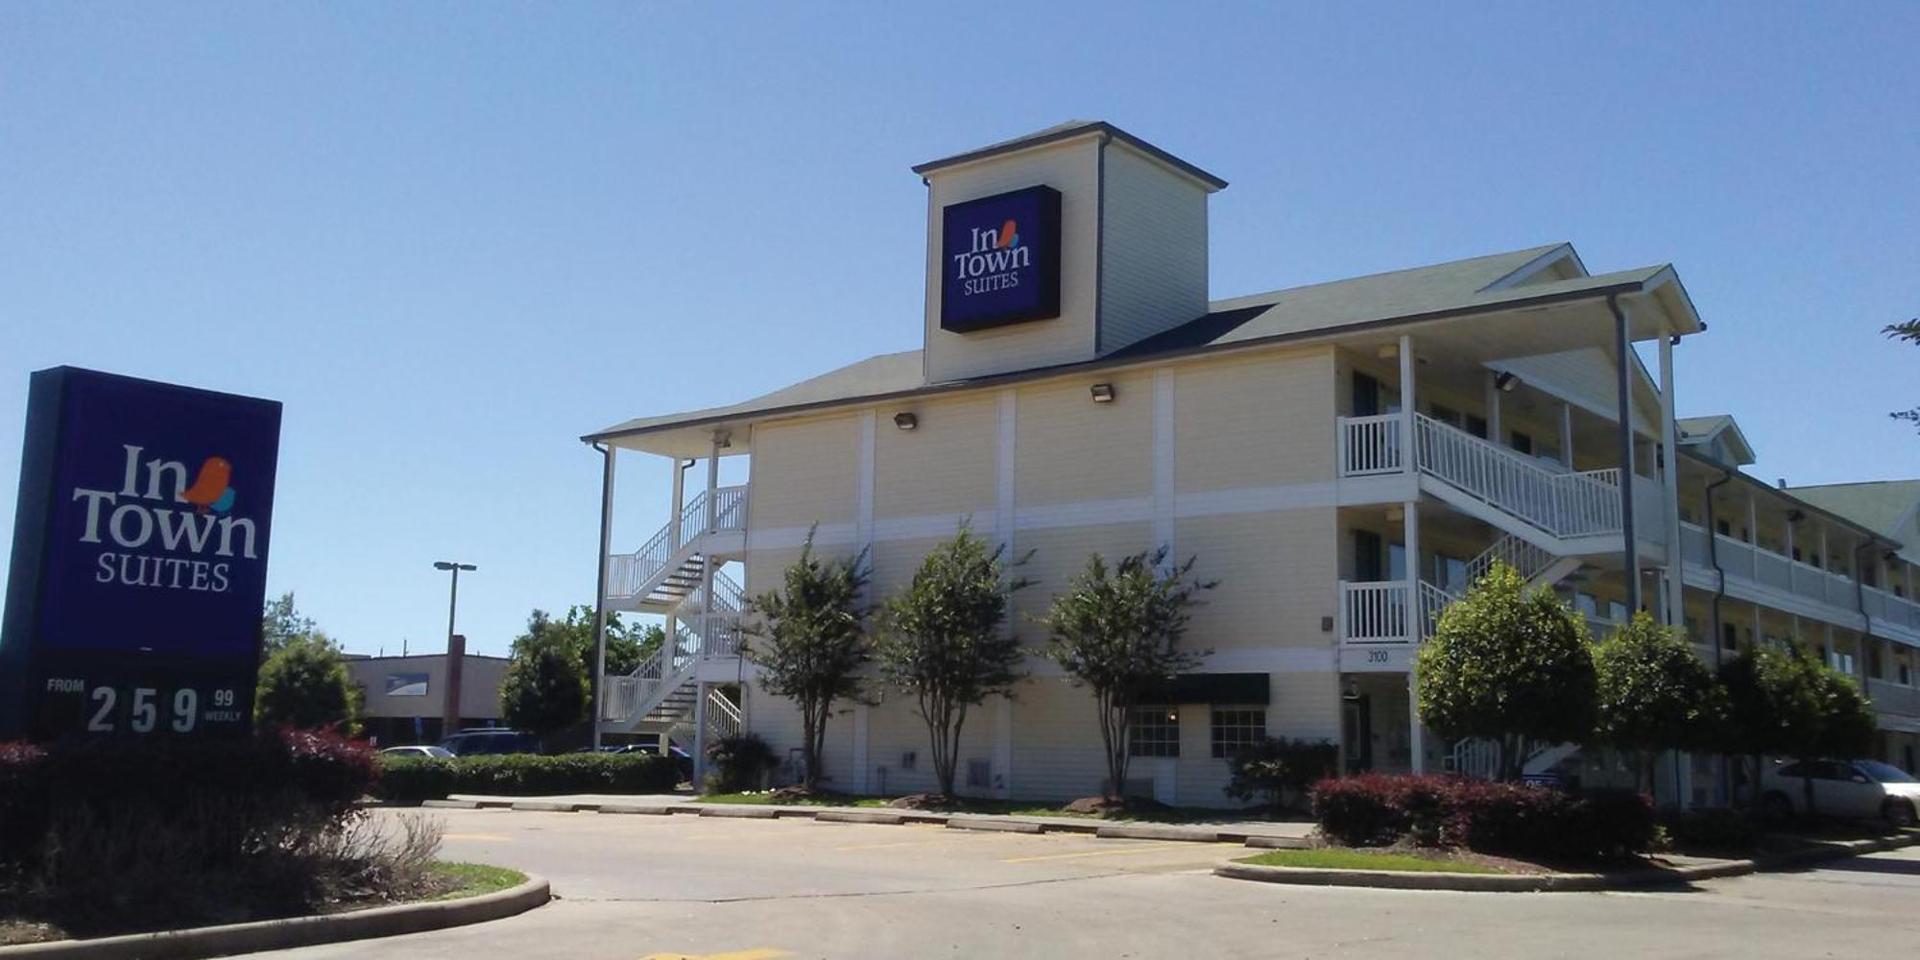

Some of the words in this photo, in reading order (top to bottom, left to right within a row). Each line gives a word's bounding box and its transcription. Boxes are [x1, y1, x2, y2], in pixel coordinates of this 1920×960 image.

[971, 227, 999, 253] In
[954, 246, 1030, 279] Town
[964, 271, 1019, 296] SUITES
[118, 444, 189, 504] In
[72, 487, 258, 560] Town
[96, 552, 230, 593] SUITES
[1367, 650, 1389, 663] 3100
[47, 678, 85, 693] FROM
[88, 686, 198, 733] 259
[214, 689, 235, 706] 99
[205, 711, 242, 722] WEEKLY
